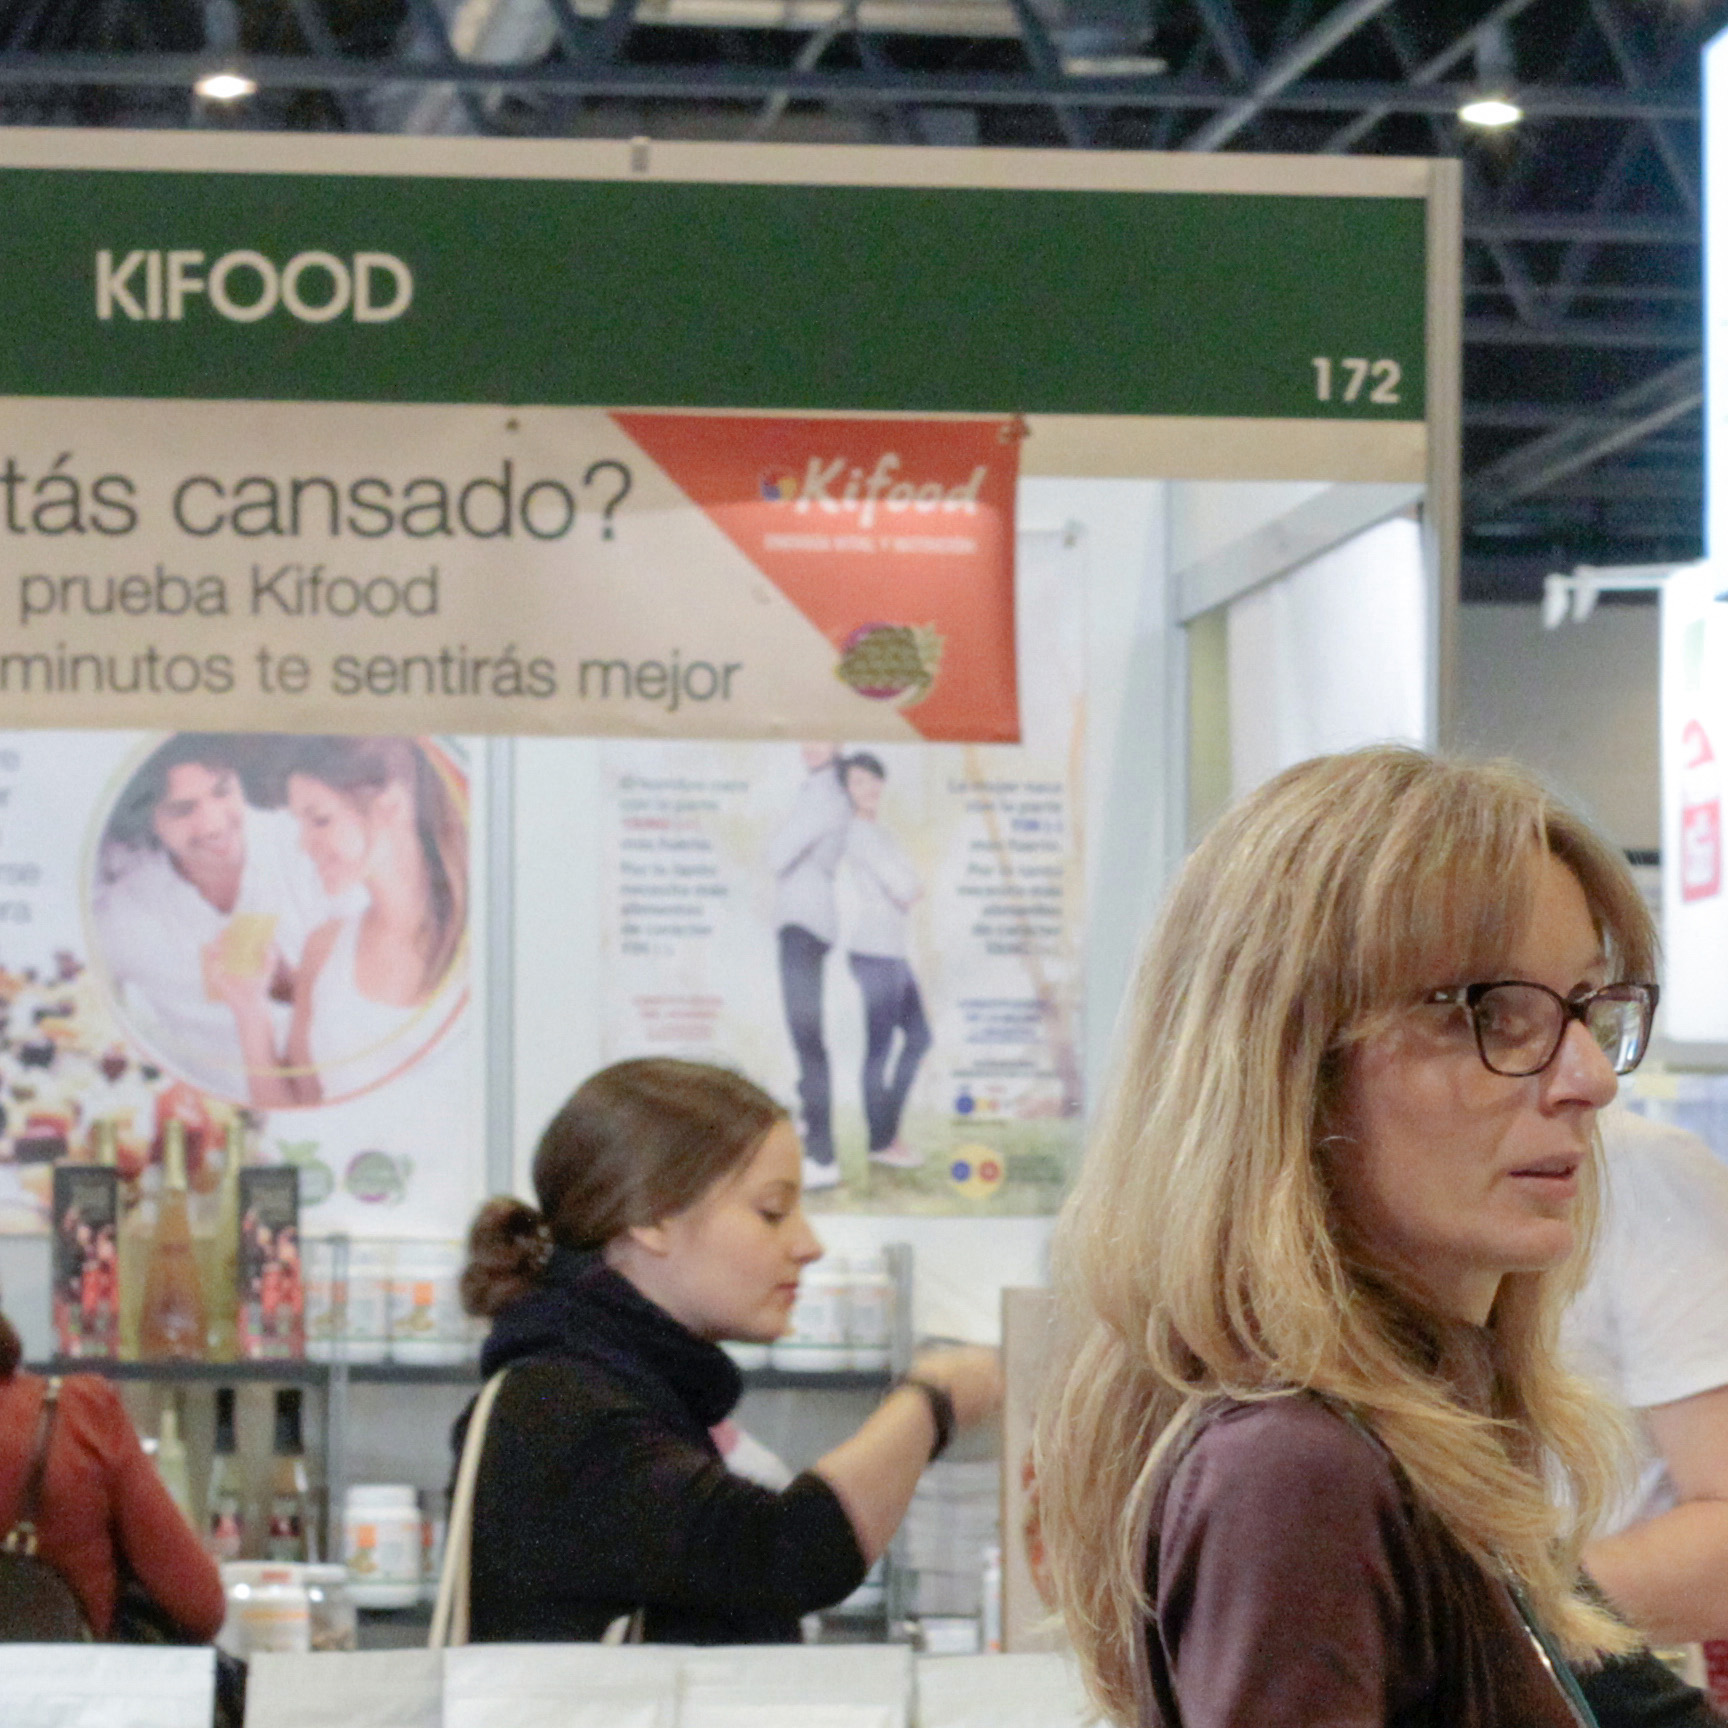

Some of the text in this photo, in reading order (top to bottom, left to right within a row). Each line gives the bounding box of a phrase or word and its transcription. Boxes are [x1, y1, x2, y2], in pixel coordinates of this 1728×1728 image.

[94, 250, 413, 323] KIFOOD
[1310, 357, 1402, 404] 172
[0, 450, 634, 542] tás cansado?
[793, 452, 989, 528] Kifood
[19, 563, 441, 625] prueba Kifood
[0, 642, 742, 713] minutos te sentirás mejor
